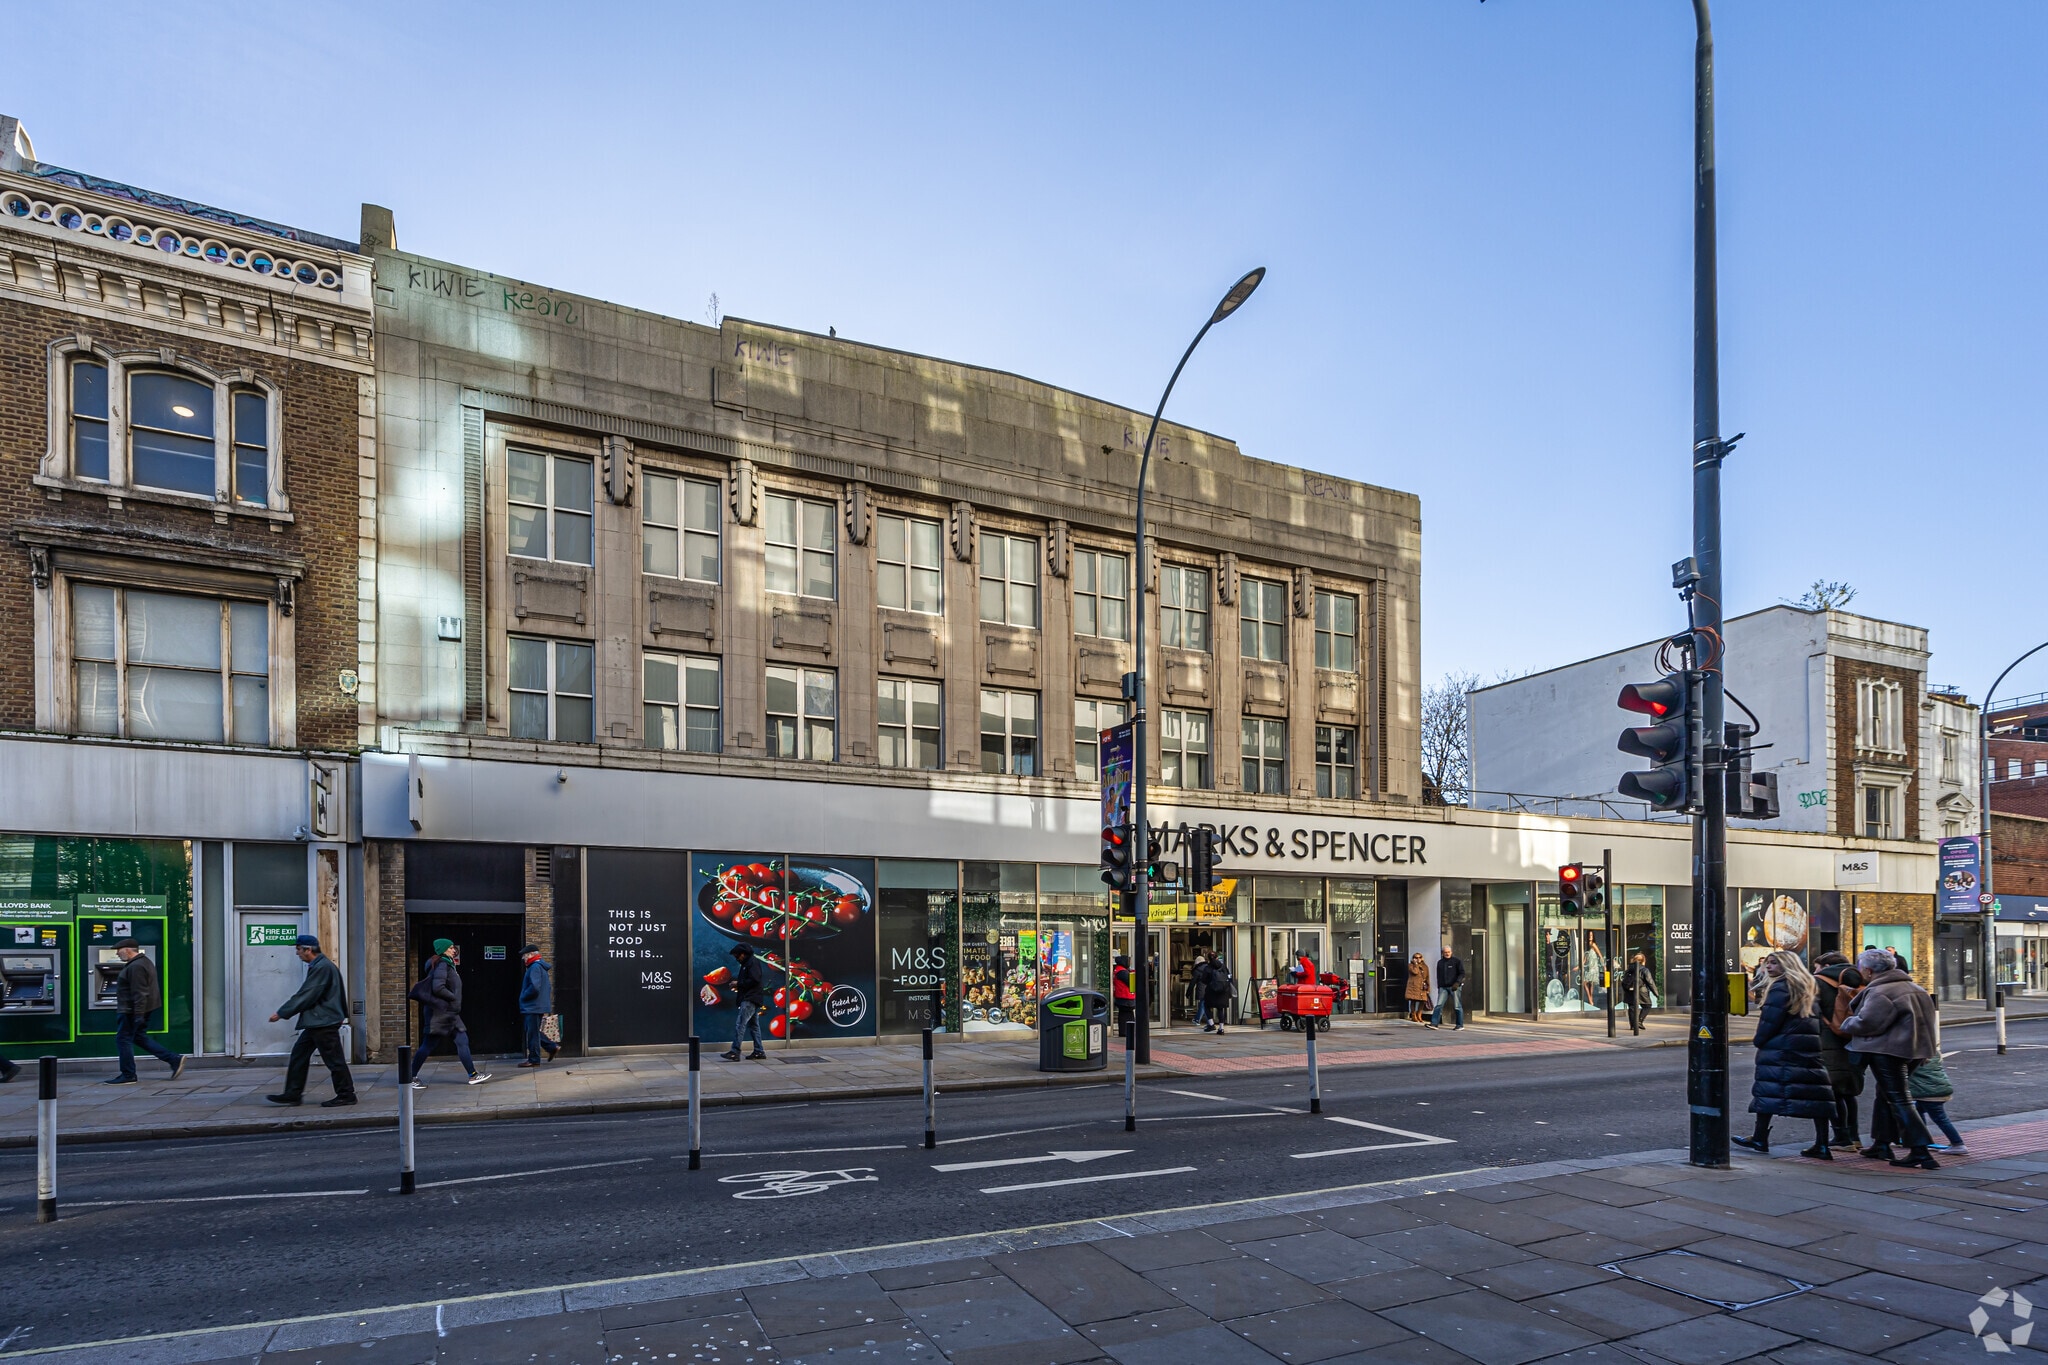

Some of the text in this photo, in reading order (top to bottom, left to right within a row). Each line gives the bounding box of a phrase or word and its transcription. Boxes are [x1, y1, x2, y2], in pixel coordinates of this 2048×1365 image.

[408, 264, 485, 298] KIWIE
[734, 333, 796, 366] KIWIE
[1265, 826, 1286, 858] &
[1290, 828, 1428, 865] SPENCER
[1842, 862, 1869, 871] M&S
[608, 910, 651, 919] THIS IS
[609, 923, 667, 932] NOT JUST
[1672, 923, 1688, 931] CLICK
[609, 937, 643, 945] FOOD
[608, 950, 663, 958] THIS IS...
[892, 946, 946, 970] M&S
[641, 971, 672, 984] M&S
[901, 975, 938, 985] FOOD
